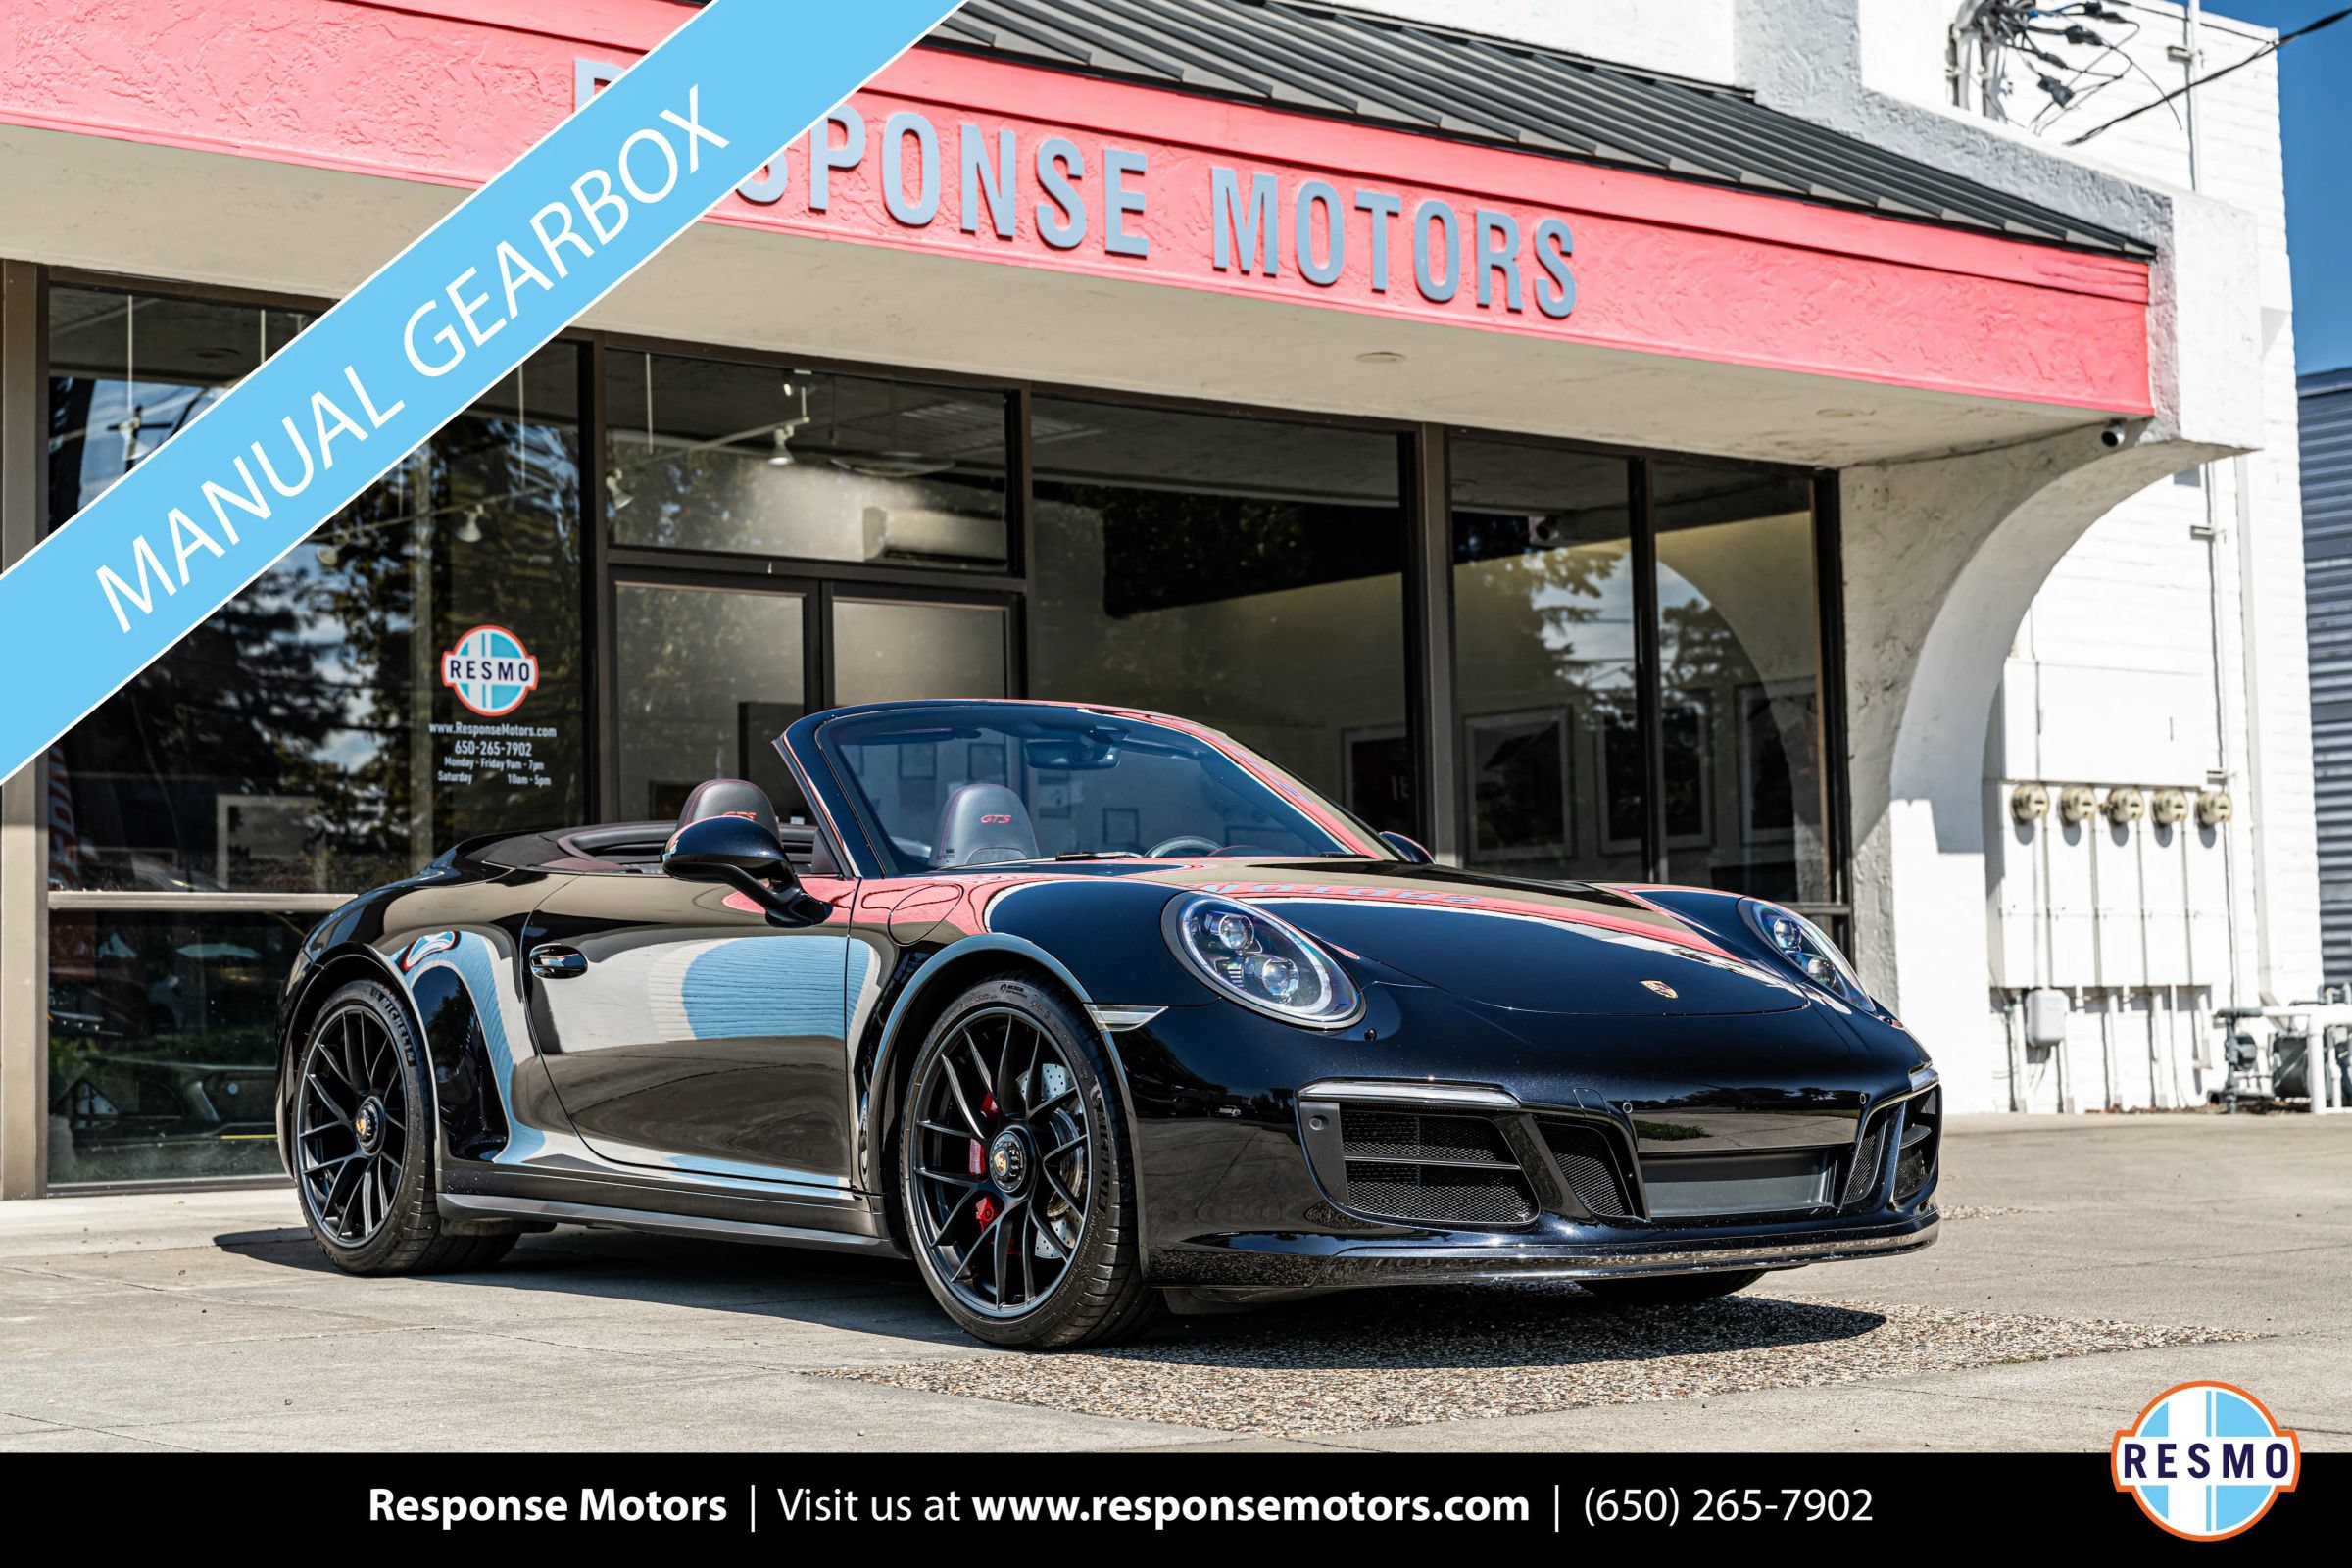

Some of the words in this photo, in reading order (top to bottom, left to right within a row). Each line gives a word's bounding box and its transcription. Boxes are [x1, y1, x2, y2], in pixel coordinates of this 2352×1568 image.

[573, 58, 1149, 259] PONSE
[1210, 166, 1577, 319] MOTORS
[450, 660, 530, 682] RESMO
[428, 721, 558, 738] www.ResponseMotors.com
[455, 740, 532, 757] 650-265-7902
[444, 757, 474, 770] Monday
[480, 758, 505, 772] Friday
[506, 759, 522, 770] 9am
[528, 760, 545, 772] 7pm
[437, 770, 473, 785] Saturday
[508, 773, 528, 785] 10am
[534, 774, 552, 788] 5pm
[980, 814, 1011, 824] GTS
[379, 998, 416, 1063] MICHELIN
